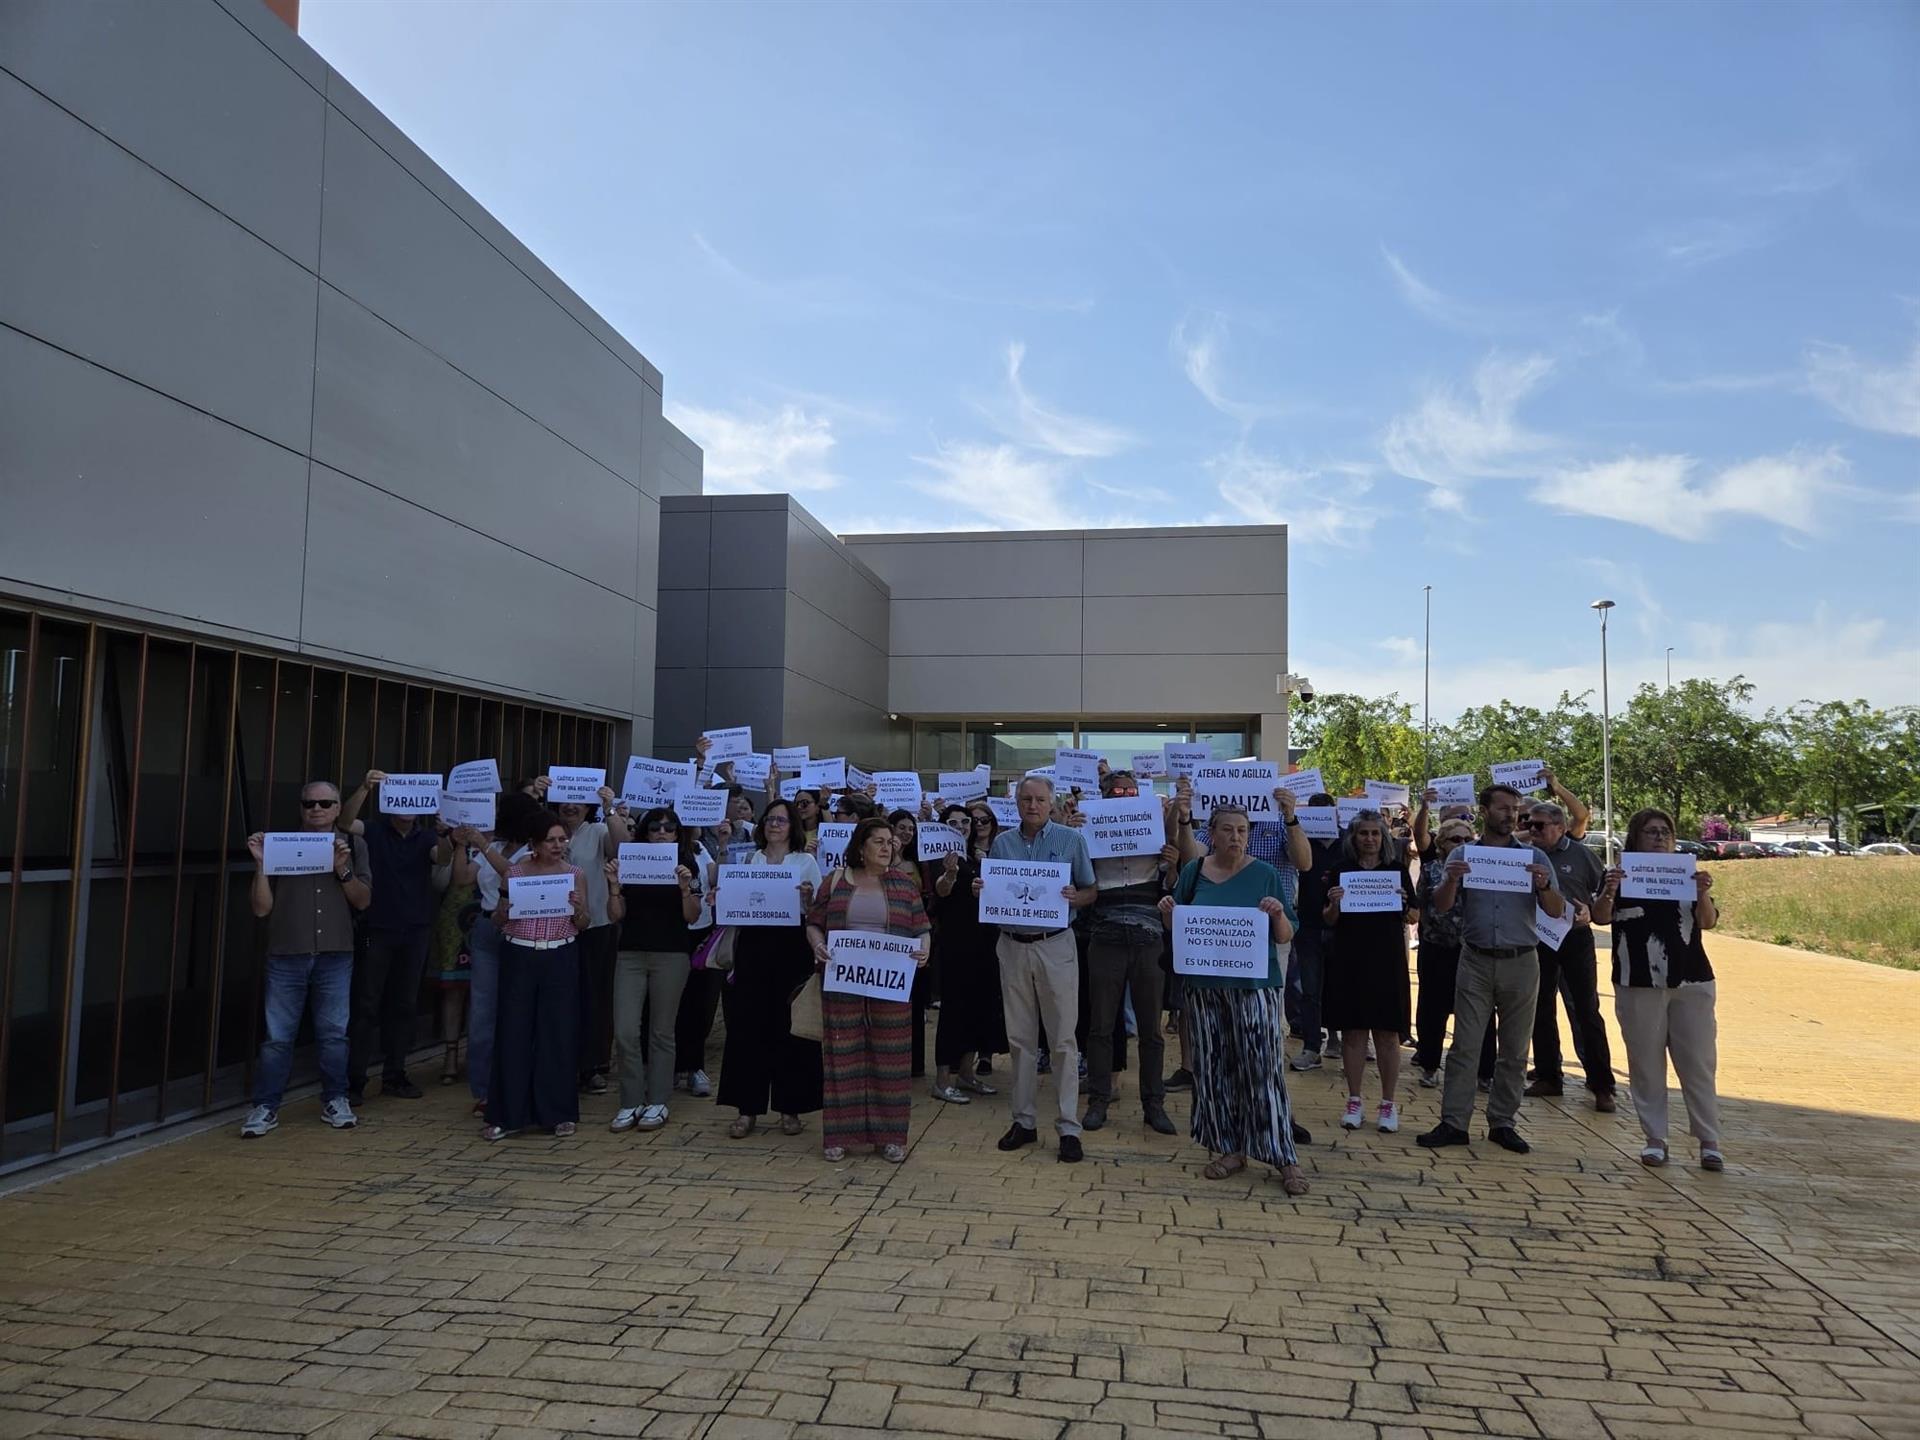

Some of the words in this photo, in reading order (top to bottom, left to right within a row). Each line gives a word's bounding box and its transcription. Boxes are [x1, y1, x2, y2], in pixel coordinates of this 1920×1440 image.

[633, 761, 655, 772] JUSTICIA
[655, 765, 689, 776] COLAPSADA
[1197, 768, 1226, 778] ATENEA
[1228, 768, 1240, 778] NO
[1242, 768, 1272, 779] AGILIZA
[387, 796, 438, 808] PARALIZA
[625, 793, 637, 801] POR
[637, 794, 654, 804] FALTA
[655, 797, 663, 805] DE
[1092, 813, 1118, 825] CAÓTICA
[1119, 811, 1152, 823] SITUACIÓN
[823, 829, 848, 838] ATENEA
[1094, 831, 1108, 839] POR
[1109, 830, 1123, 838] UNA
[1124, 827, 1152, 837] NEFASTA
[1110, 841, 1138, 852] GESTIÓN
[1467, 856, 1496, 865] GESTIÓN
[1497, 859, 1526, 867] FALLIDA
[621, 872, 647, 880] JUSTICIA
[725, 871, 749, 879] JUSTICIA
[750, 871, 792, 879] DESORDENADA
[988, 866, 1018, 876] JUSTICIA
[1020, 868, 1060, 878] COLAPSADA
[726, 911, 750, 919] JUSTICIA
[985, 906, 999, 916] POR
[1000, 907, 1021, 917] FALTA
[1022, 909, 1031, 918] DE
[1033, 909, 1059, 919] MEDIOS
[1199, 917, 1253, 927] FORMACIÓN
[1184, 927, 1256, 937] PERSONALIZADA
[834, 937, 866, 949] ATENEA
[869, 940, 881, 950] NO
[883, 942, 914, 953] AGILIZA
[1203, 938, 1213, 946] ES
[1215, 939, 1228, 947] UN
[1229, 940, 1252, 948] LUJO
[1185, 958, 1195, 966] ES
[1197, 958, 1210, 967] UN
[1212, 959, 1253, 969] DERECHO
[836, 964, 905, 990] PARALIZA
